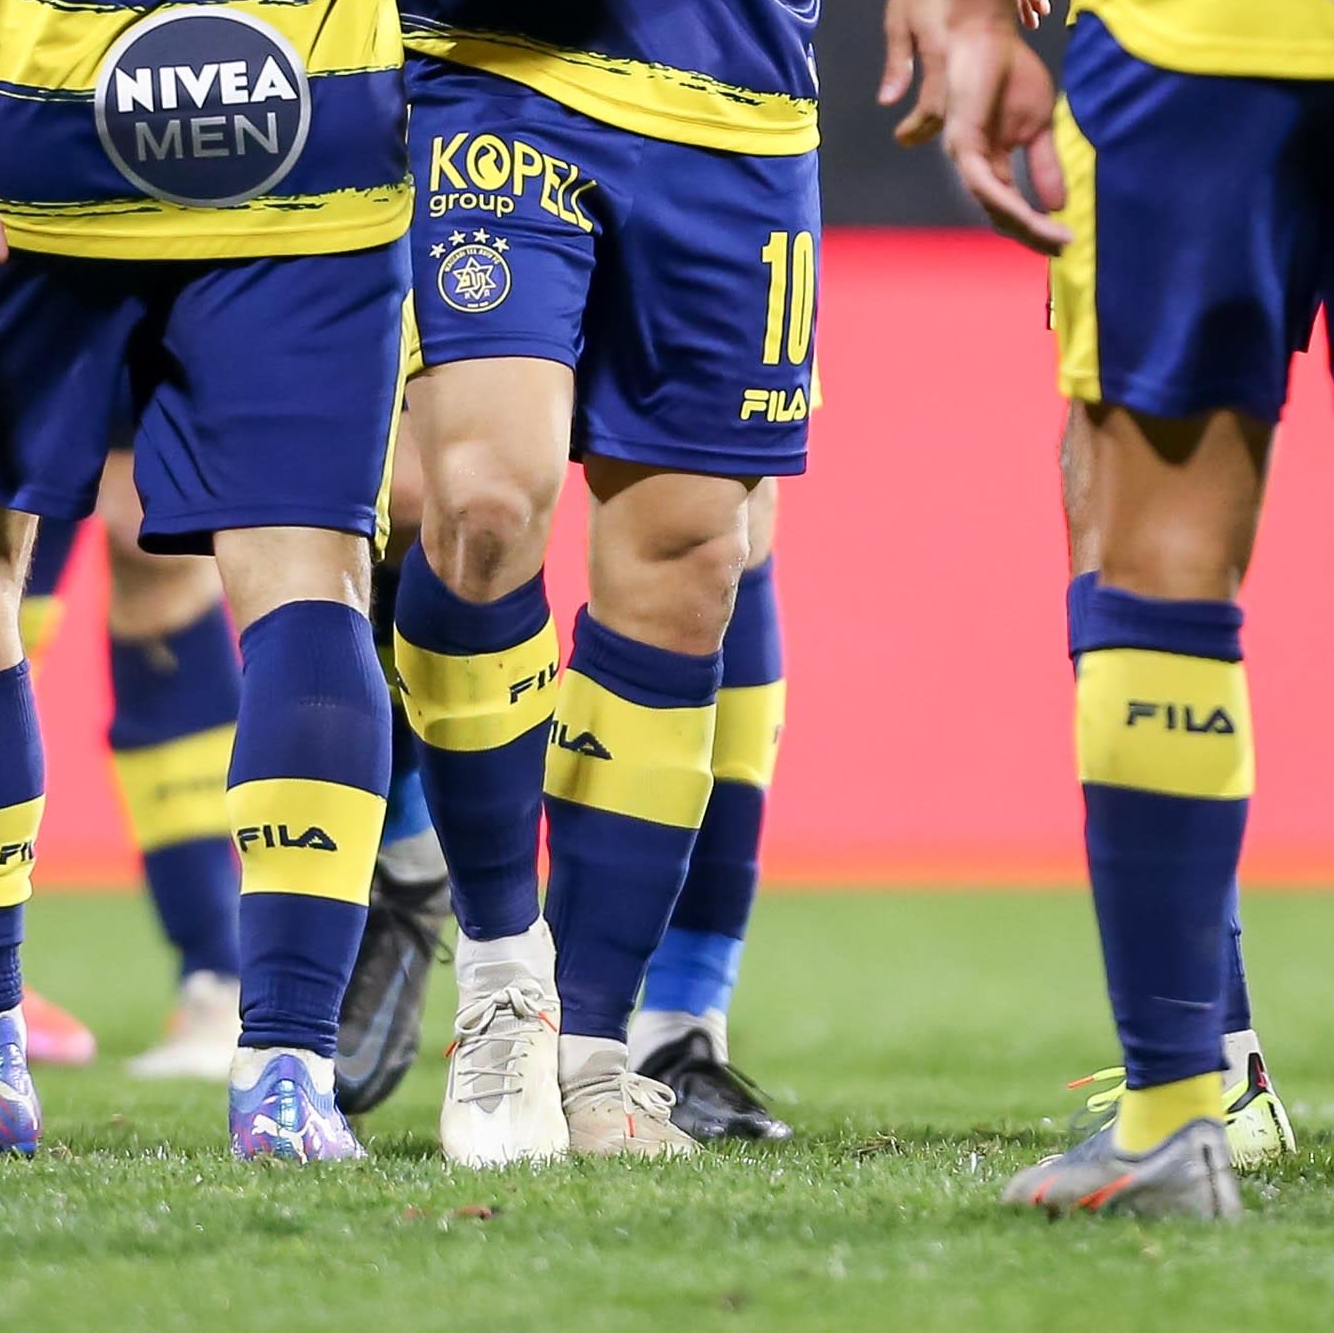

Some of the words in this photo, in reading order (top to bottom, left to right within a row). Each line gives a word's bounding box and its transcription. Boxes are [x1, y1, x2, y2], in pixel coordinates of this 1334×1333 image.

[116, 55, 298, 113] NIVEA
[135, 112, 279, 162] MEN
[429, 192, 515, 218] group
[762, 231, 814, 365] 10
[741, 389, 807, 422] FILA
[509, 662, 556, 704] FIL
[1127, 702, 1234, 734] FILA
[551, 720, 613, 760] ILA
[237, 825, 338, 852] FILA
